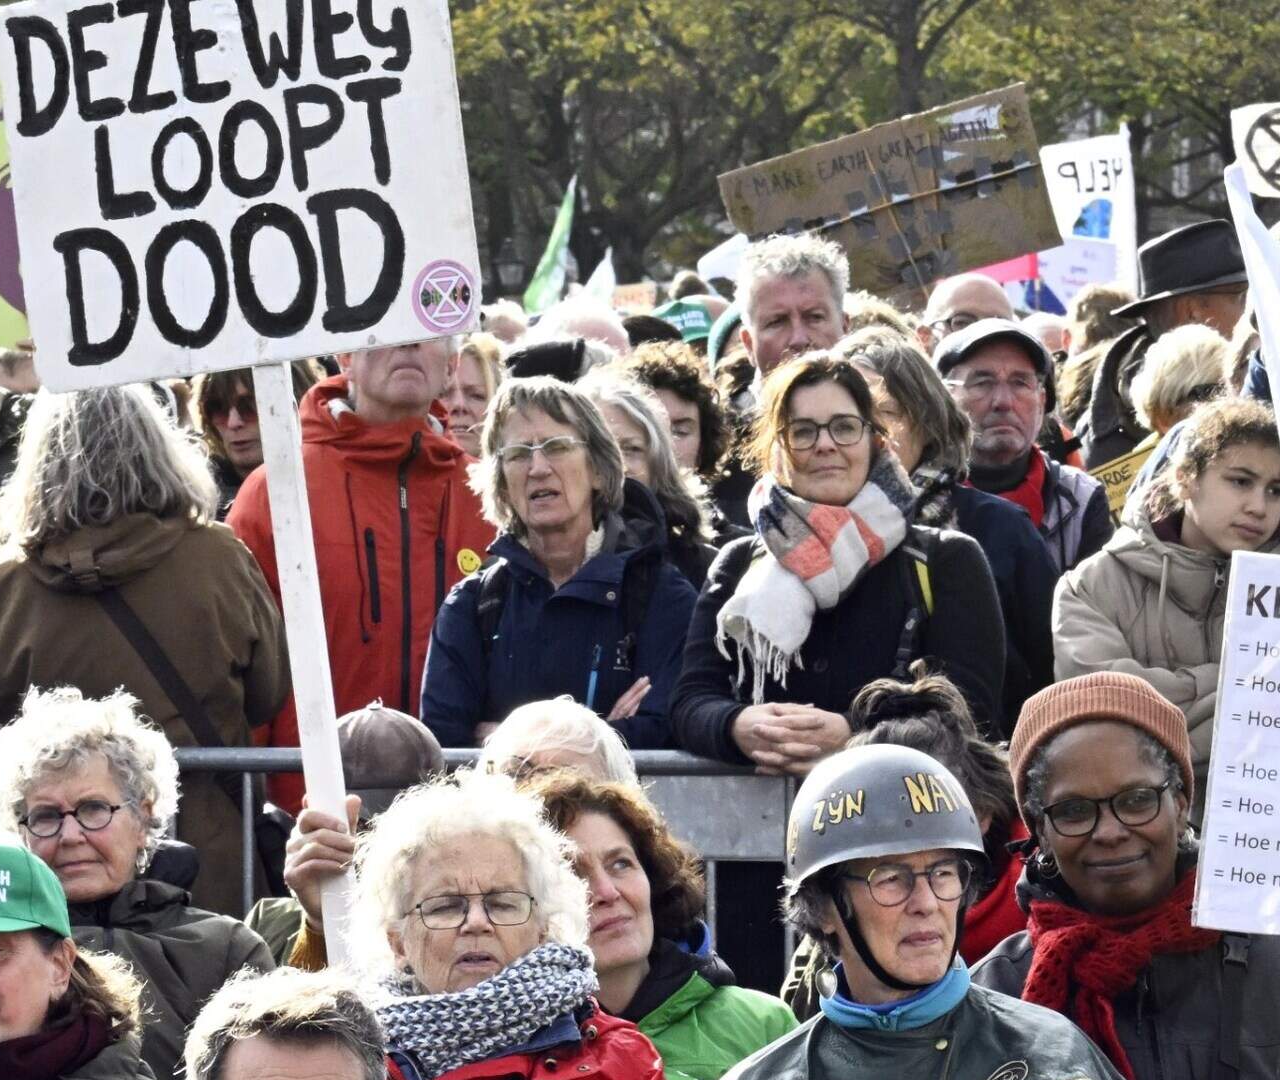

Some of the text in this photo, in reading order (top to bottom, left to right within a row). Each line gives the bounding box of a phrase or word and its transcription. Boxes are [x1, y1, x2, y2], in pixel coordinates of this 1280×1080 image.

[95, 77, 402, 220] LOOPT
[53, 188, 406, 366] DOOD
[1242, 763, 1278, 781] Hoe
[1238, 798, 1274, 815] Hoe
[1234, 832, 1270, 850] Hoe
[1230, 867, 1266, 885] Hoe
